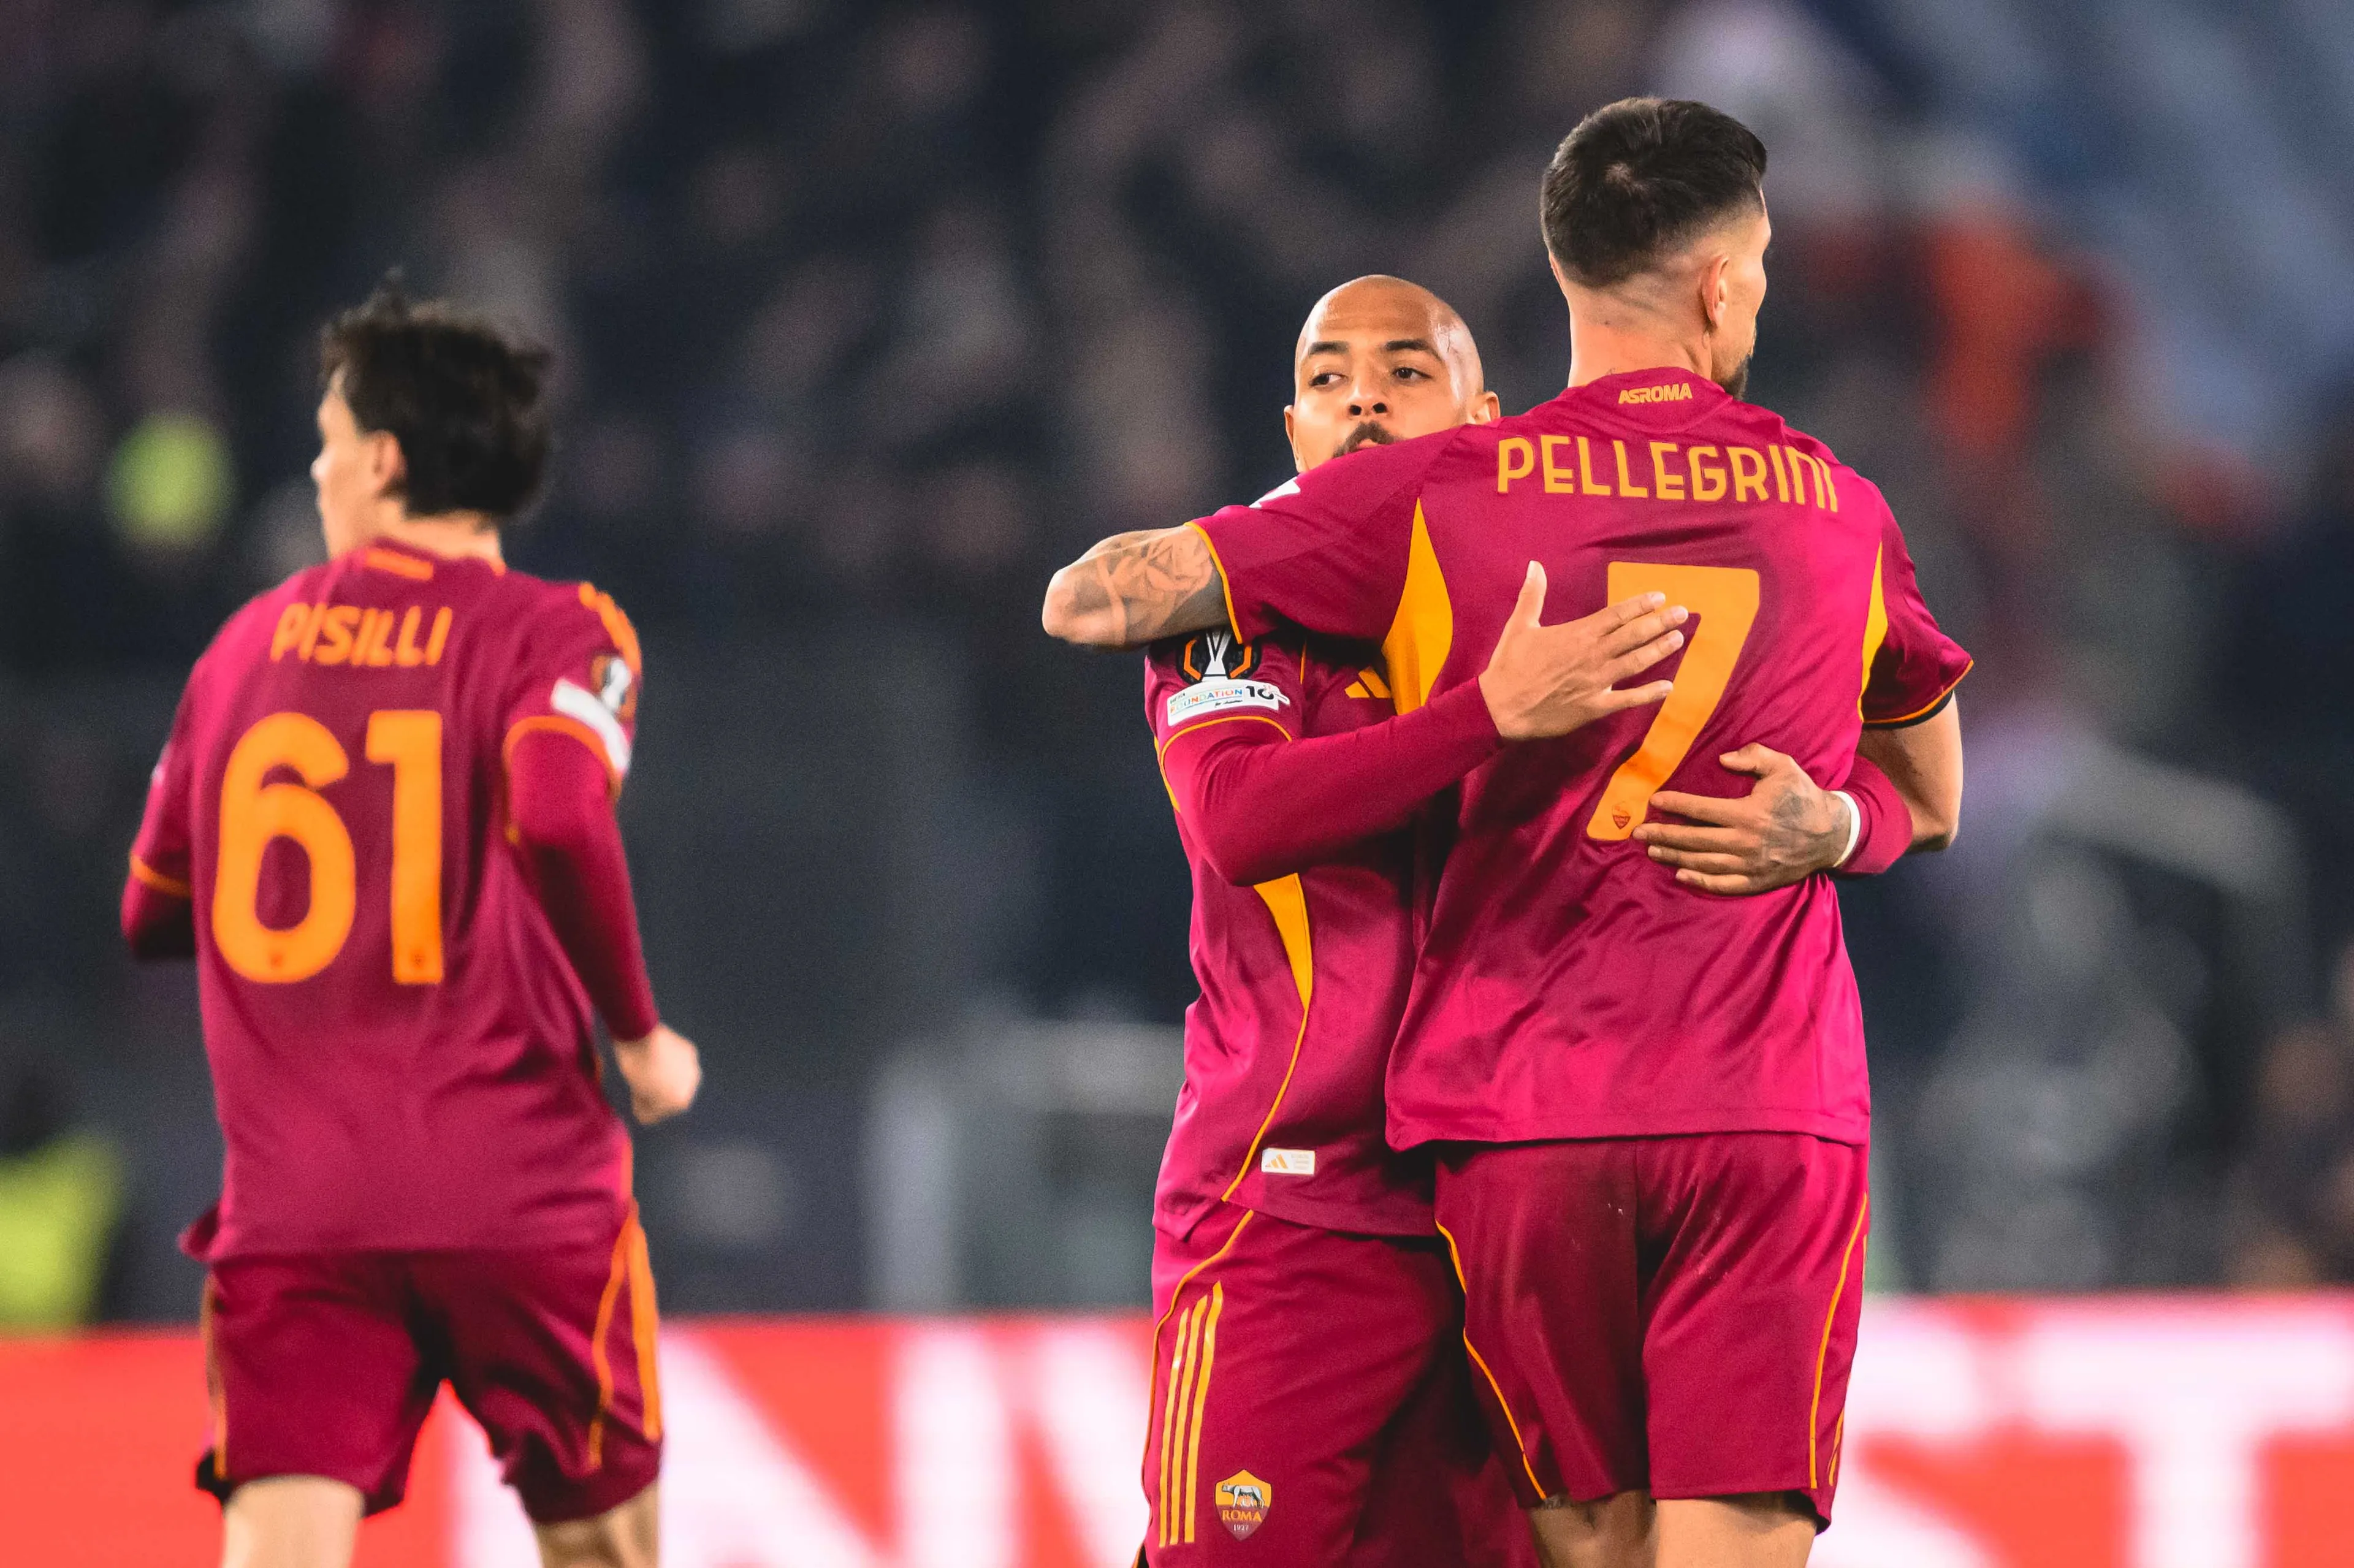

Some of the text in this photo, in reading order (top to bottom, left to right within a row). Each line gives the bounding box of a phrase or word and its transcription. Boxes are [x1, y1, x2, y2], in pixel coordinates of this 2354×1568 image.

[1497, 435, 1838, 513] PELLEGRINI
[270, 602, 452, 668] PISILLI
[1586, 561, 1760, 842] 7
[211, 709, 443, 985] 61
[1222, 1509, 1263, 1522] ROMA
